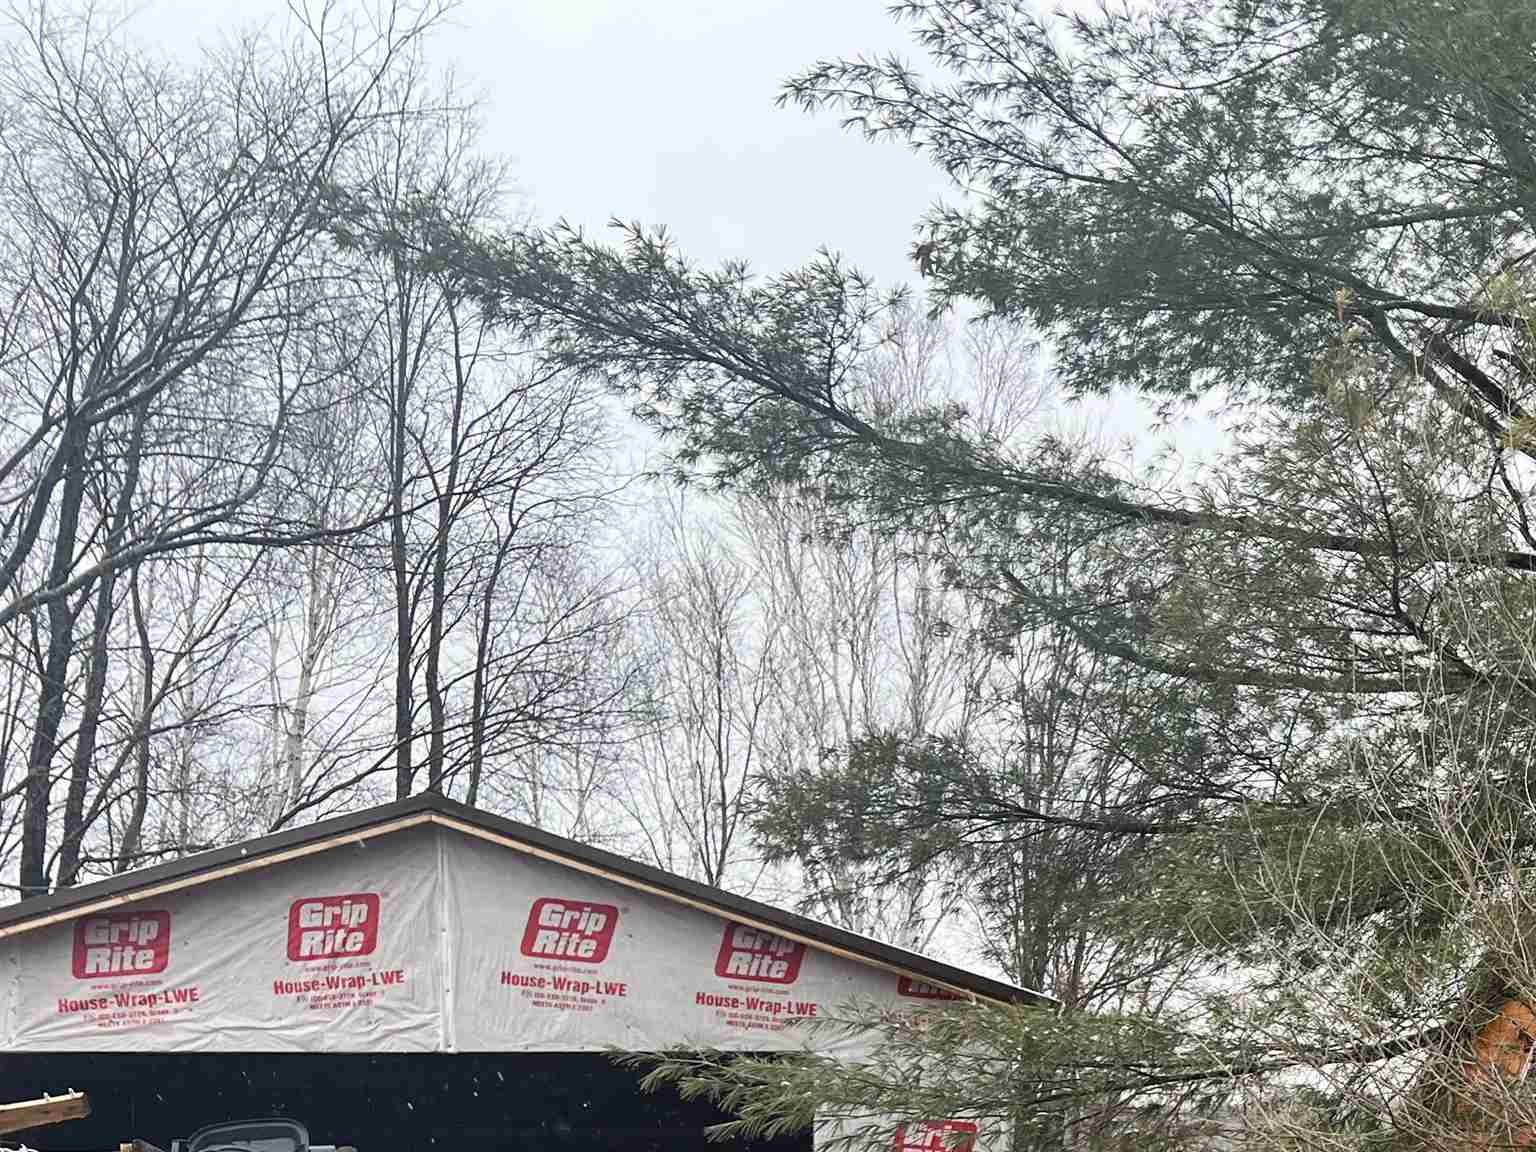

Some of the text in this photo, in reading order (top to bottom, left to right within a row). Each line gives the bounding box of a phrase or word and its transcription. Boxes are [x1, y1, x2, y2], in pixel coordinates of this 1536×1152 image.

[300, 900, 369, 929] Grip
[538, 903, 608, 936] Grip
[84, 917, 161, 946] Grip
[300, 928, 365, 957] Rite
[531, 929, 598, 958] Rite
[85, 945, 155, 974] Rite
[725, 951, 790, 979] Rite
[273, 969, 405, 995] House-Wrap-LWE
[500, 971, 628, 998] House-Wrap-LWE
[58, 987, 200, 1014] House-Wrap-LWE
[695, 991, 817, 1017] House-Wrap-LWE
